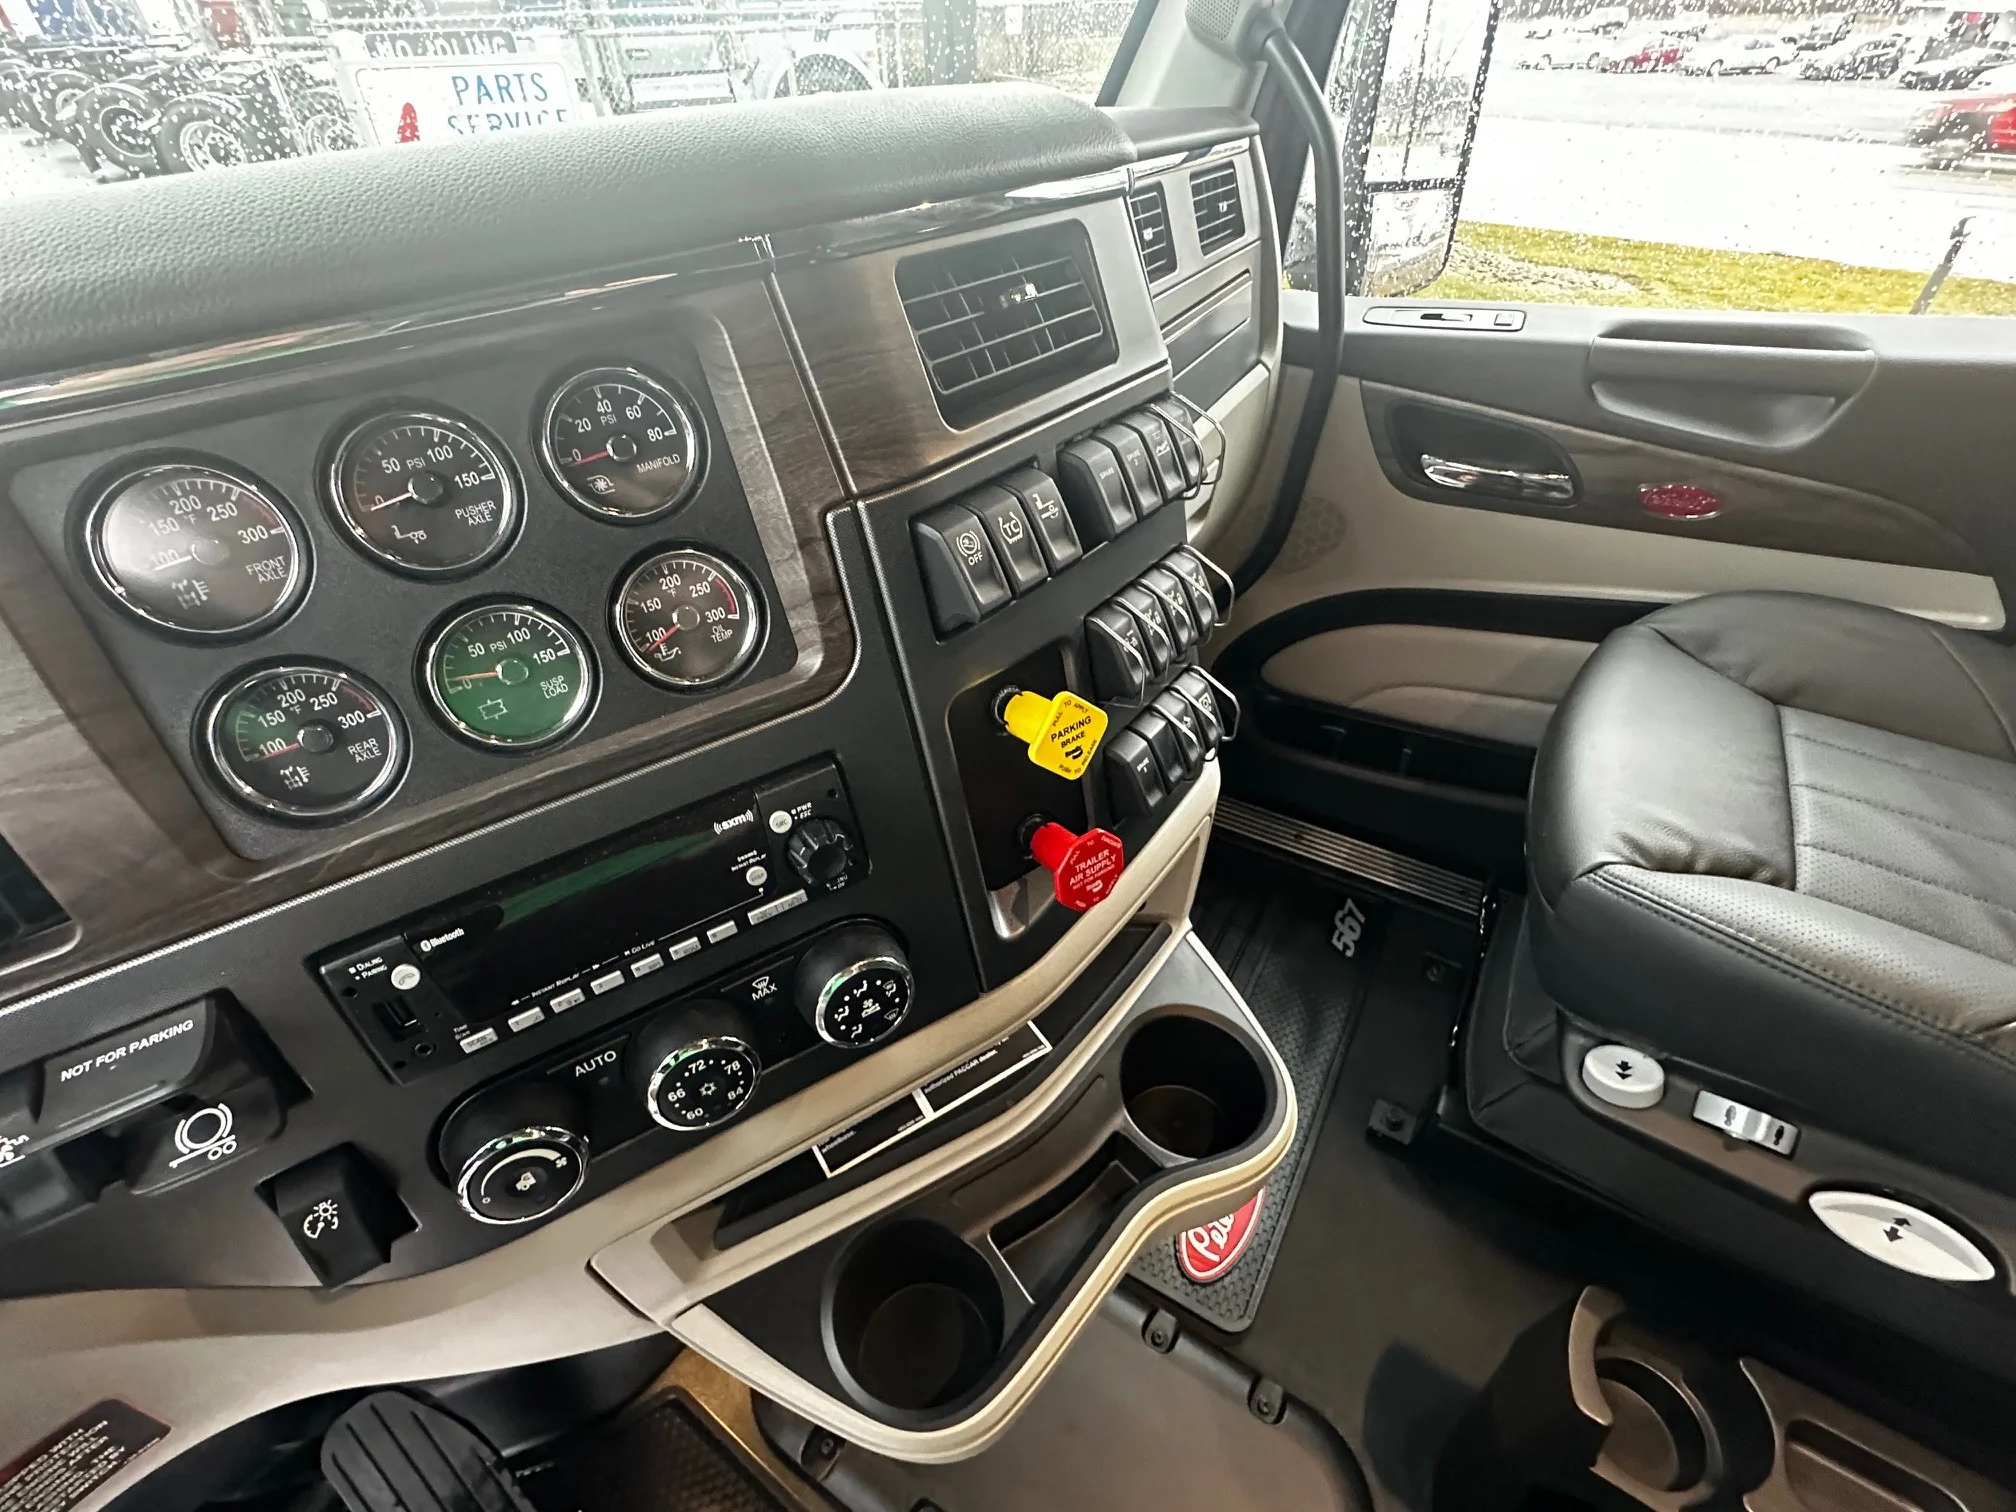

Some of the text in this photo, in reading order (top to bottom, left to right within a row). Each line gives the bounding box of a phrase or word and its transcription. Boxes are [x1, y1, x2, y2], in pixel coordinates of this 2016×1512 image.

[452, 72, 548, 105] PARTS
[596, 400, 612, 414] 40
[626, 404, 642, 420] 60
[574, 418, 592, 433] 20
[600, 414, 618, 426] PSI
[647, 426, 663, 442] 80
[427, 444, 453, 463] 100
[572, 448, 582, 462] 0
[382, 458, 400, 474] 50
[406, 458, 426, 470] PSI
[636, 454, 680, 474] MANIFOLD
[454, 471, 480, 489] 150
[169, 495, 202, 516] 200
[206, 502, 238, 522] 250
[455, 500, 496, 519] PUSHER
[148, 517, 180, 536] 150
[468, 512, 493, 527] AXLE
[1003, 520, 1020, 536] TC
[237, 525, 268, 544] 300
[245, 556, 286, 575] FRONT
[968, 552, 983, 566] OFF
[258, 568, 288, 584] AXLE
[659, 573, 682, 590] 200
[689, 580, 711, 598] 250
[640, 597, 662, 614] 150
[704, 606, 726, 623] 300
[506, 628, 531, 644] 100
[645, 626, 666, 643] 100
[710, 629, 734, 644] TEMP
[468, 642, 486, 658] 50
[489, 640, 508, 653] PSI
[532, 648, 556, 665] 150
[462, 678, 472, 690] 0
[540, 675, 565, 692] SUSP
[543, 682, 569, 700] LOAD
[276, 688, 306, 708] 200
[310, 692, 338, 711] 250
[258, 709, 286, 728] 150
[338, 710, 366, 729] 300
[1050, 715, 1092, 742] PARKING
[258, 737, 287, 756] 100
[348, 737, 379, 755] REAR
[1060, 730, 1086, 748] BRAKE
[354, 746, 382, 763] AXLE
[796, 802, 812, 814] PWR
[800, 809, 812, 819] ESC
[1074, 848, 1110, 873] TRAILER
[1070, 872, 1084, 886] AIR
[1086, 853, 1117, 877] SUPPLY
[1331, 897, 1365, 957] 567
[430, 927, 465, 948] Bluetooth
[752, 983, 778, 1002] MAX
[60, 1018, 194, 1082] NOT FOR PARKING
[574, 1050, 617, 1078] AUTO
[688, 1059, 707, 1075] 72
[724, 1060, 741, 1076] 78
[954, 1059, 980, 1077] PACCAR
[667, 1088, 686, 1103] 66
[727, 1086, 744, 1101] 84
[686, 1107, 704, 1121] 60
